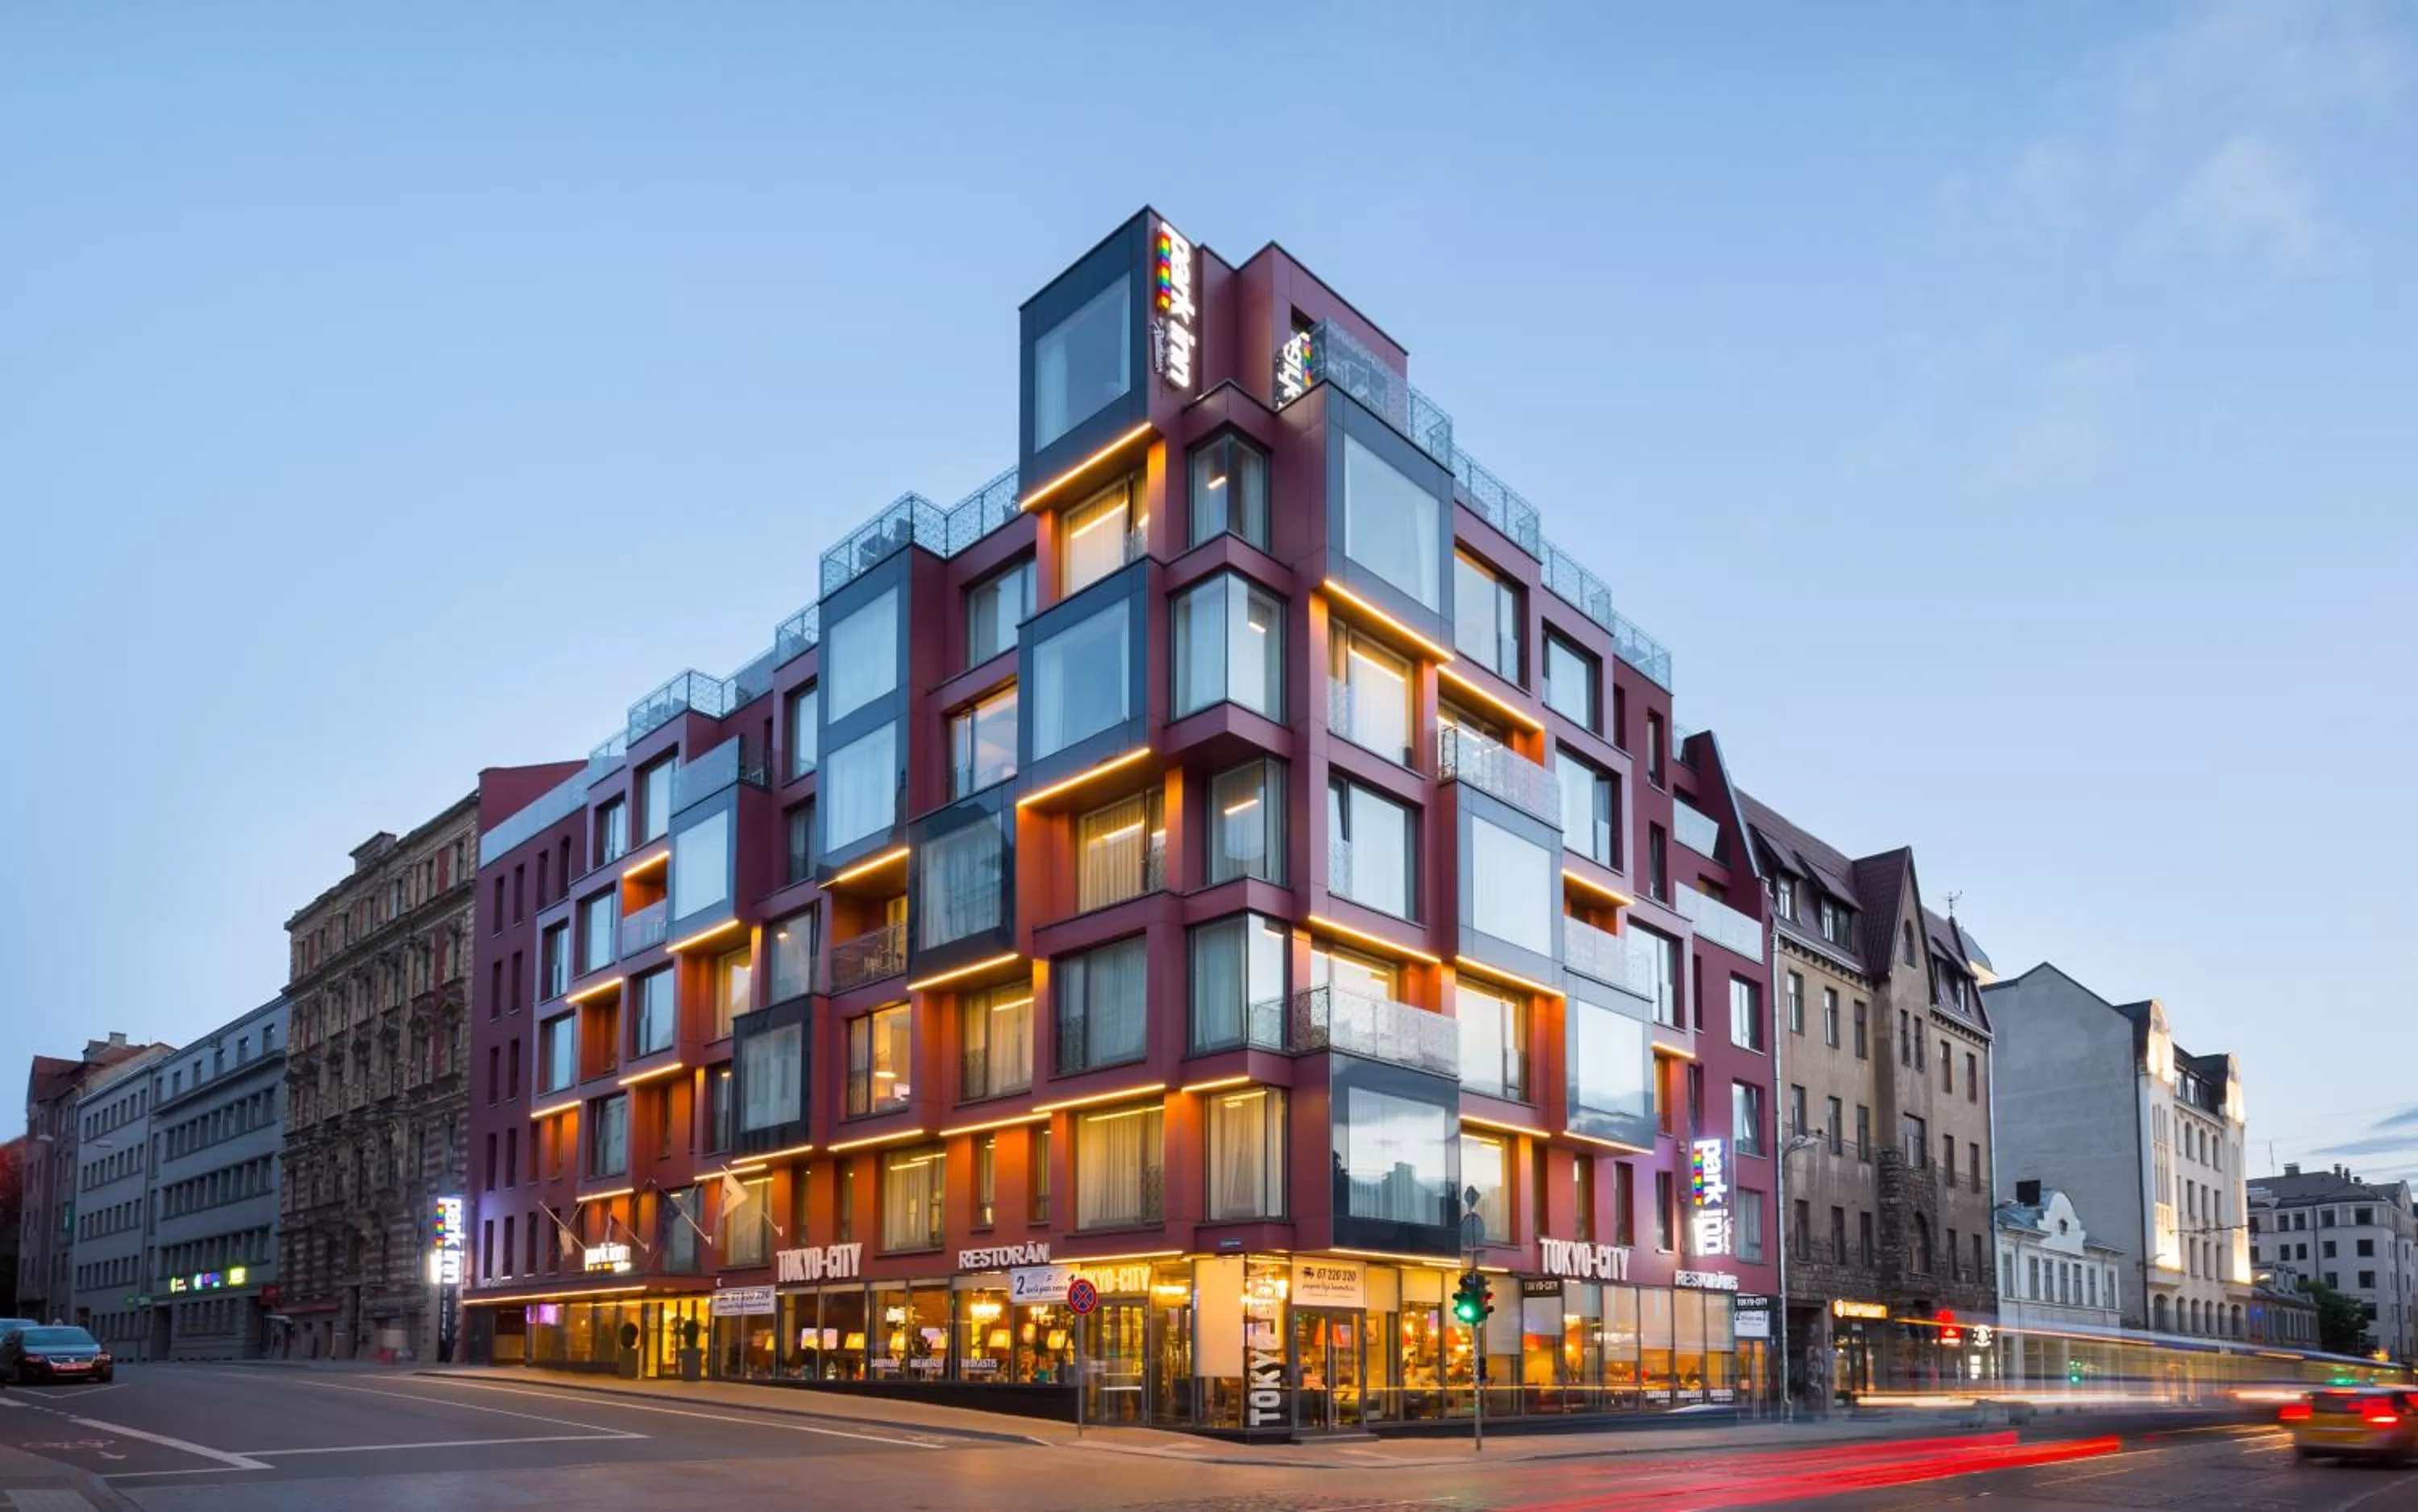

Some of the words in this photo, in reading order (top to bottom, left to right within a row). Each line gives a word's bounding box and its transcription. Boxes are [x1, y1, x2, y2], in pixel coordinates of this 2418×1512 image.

[1161, 222, 1196, 324] park
[1170, 320, 1195, 387] inn
[1693, 1139, 1727, 1206] park
[438, 1198, 466, 1247] park
[1702, 1208, 1728, 1255] inn
[442, 1250, 465, 1284] inn
[776, 1243, 863, 1282] TOKYO-CITY
[1539, 1237, 1630, 1281] TOKYO-CITY
[1016, 1275, 1024, 1295] 2
